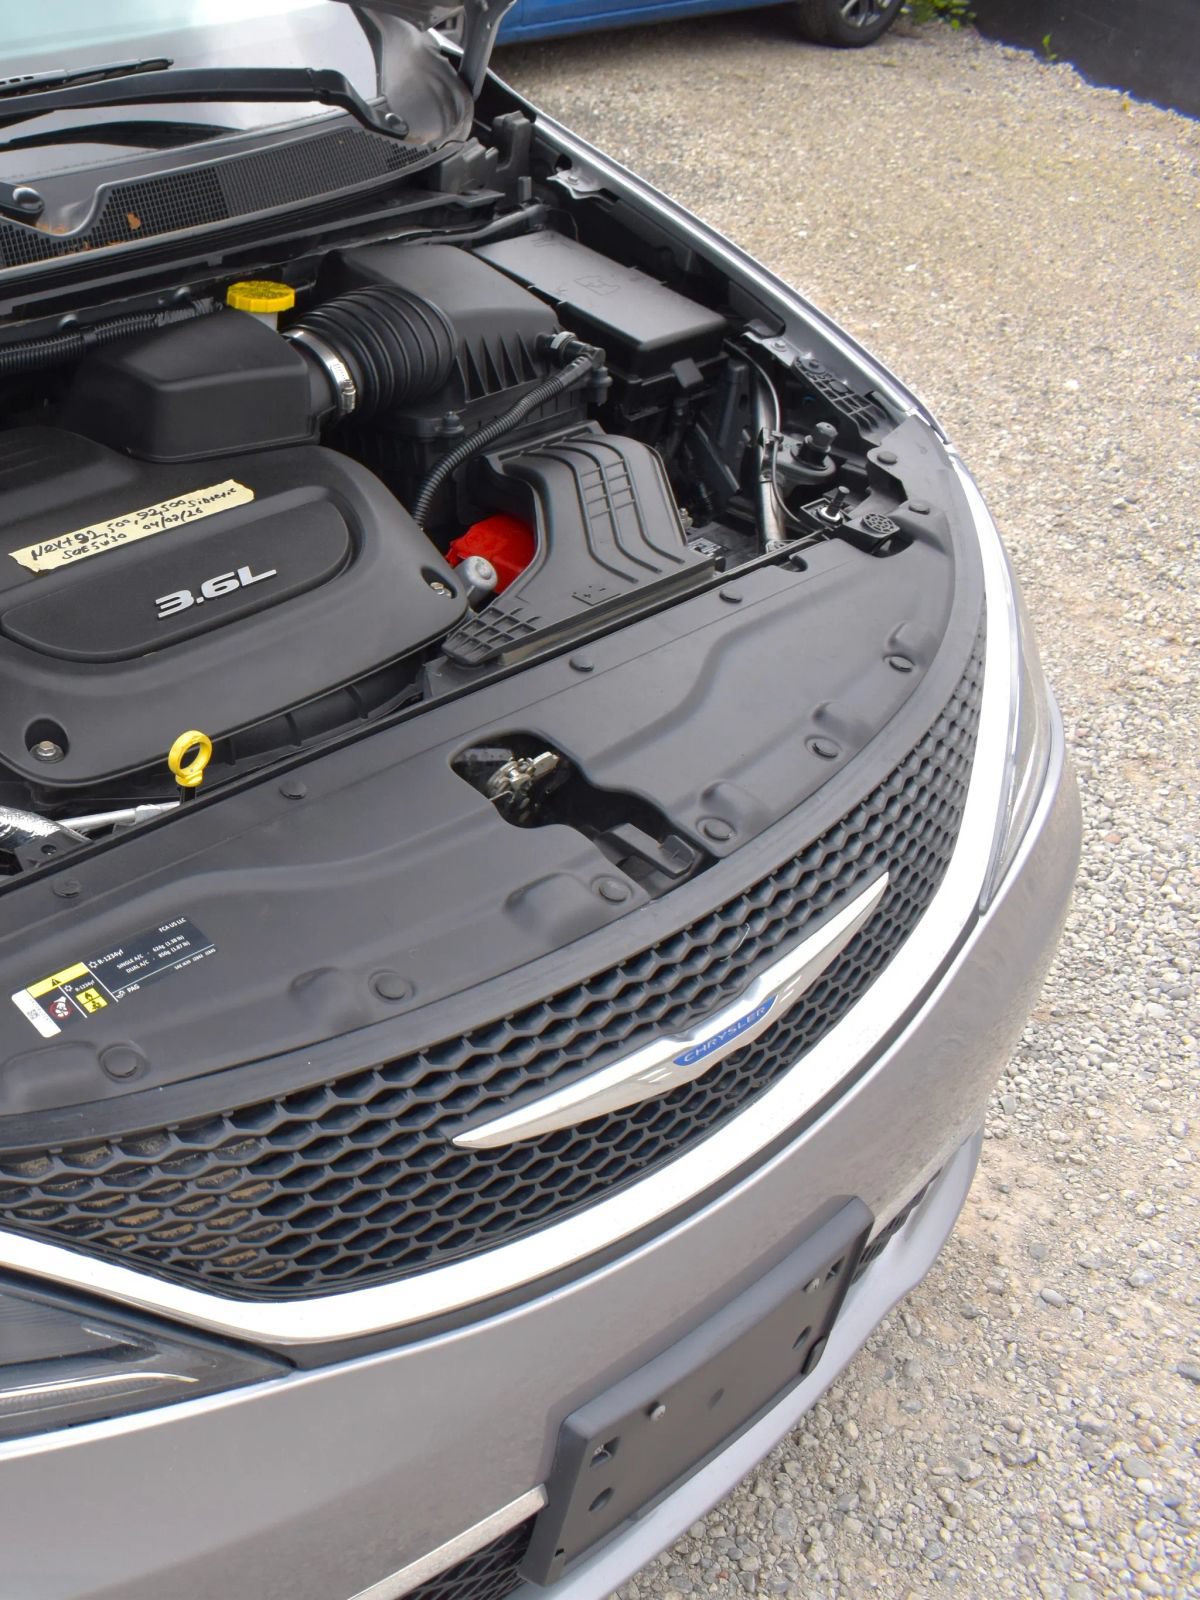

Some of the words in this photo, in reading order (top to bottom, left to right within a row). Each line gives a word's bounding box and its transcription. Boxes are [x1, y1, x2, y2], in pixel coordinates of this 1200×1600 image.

[155, 565, 277, 619] 3.6L
[97, 948, 124, 965] R-1234yf
[126, 983, 141, 994] PAG
[683, 1006, 767, 1063] CHRYSLER
